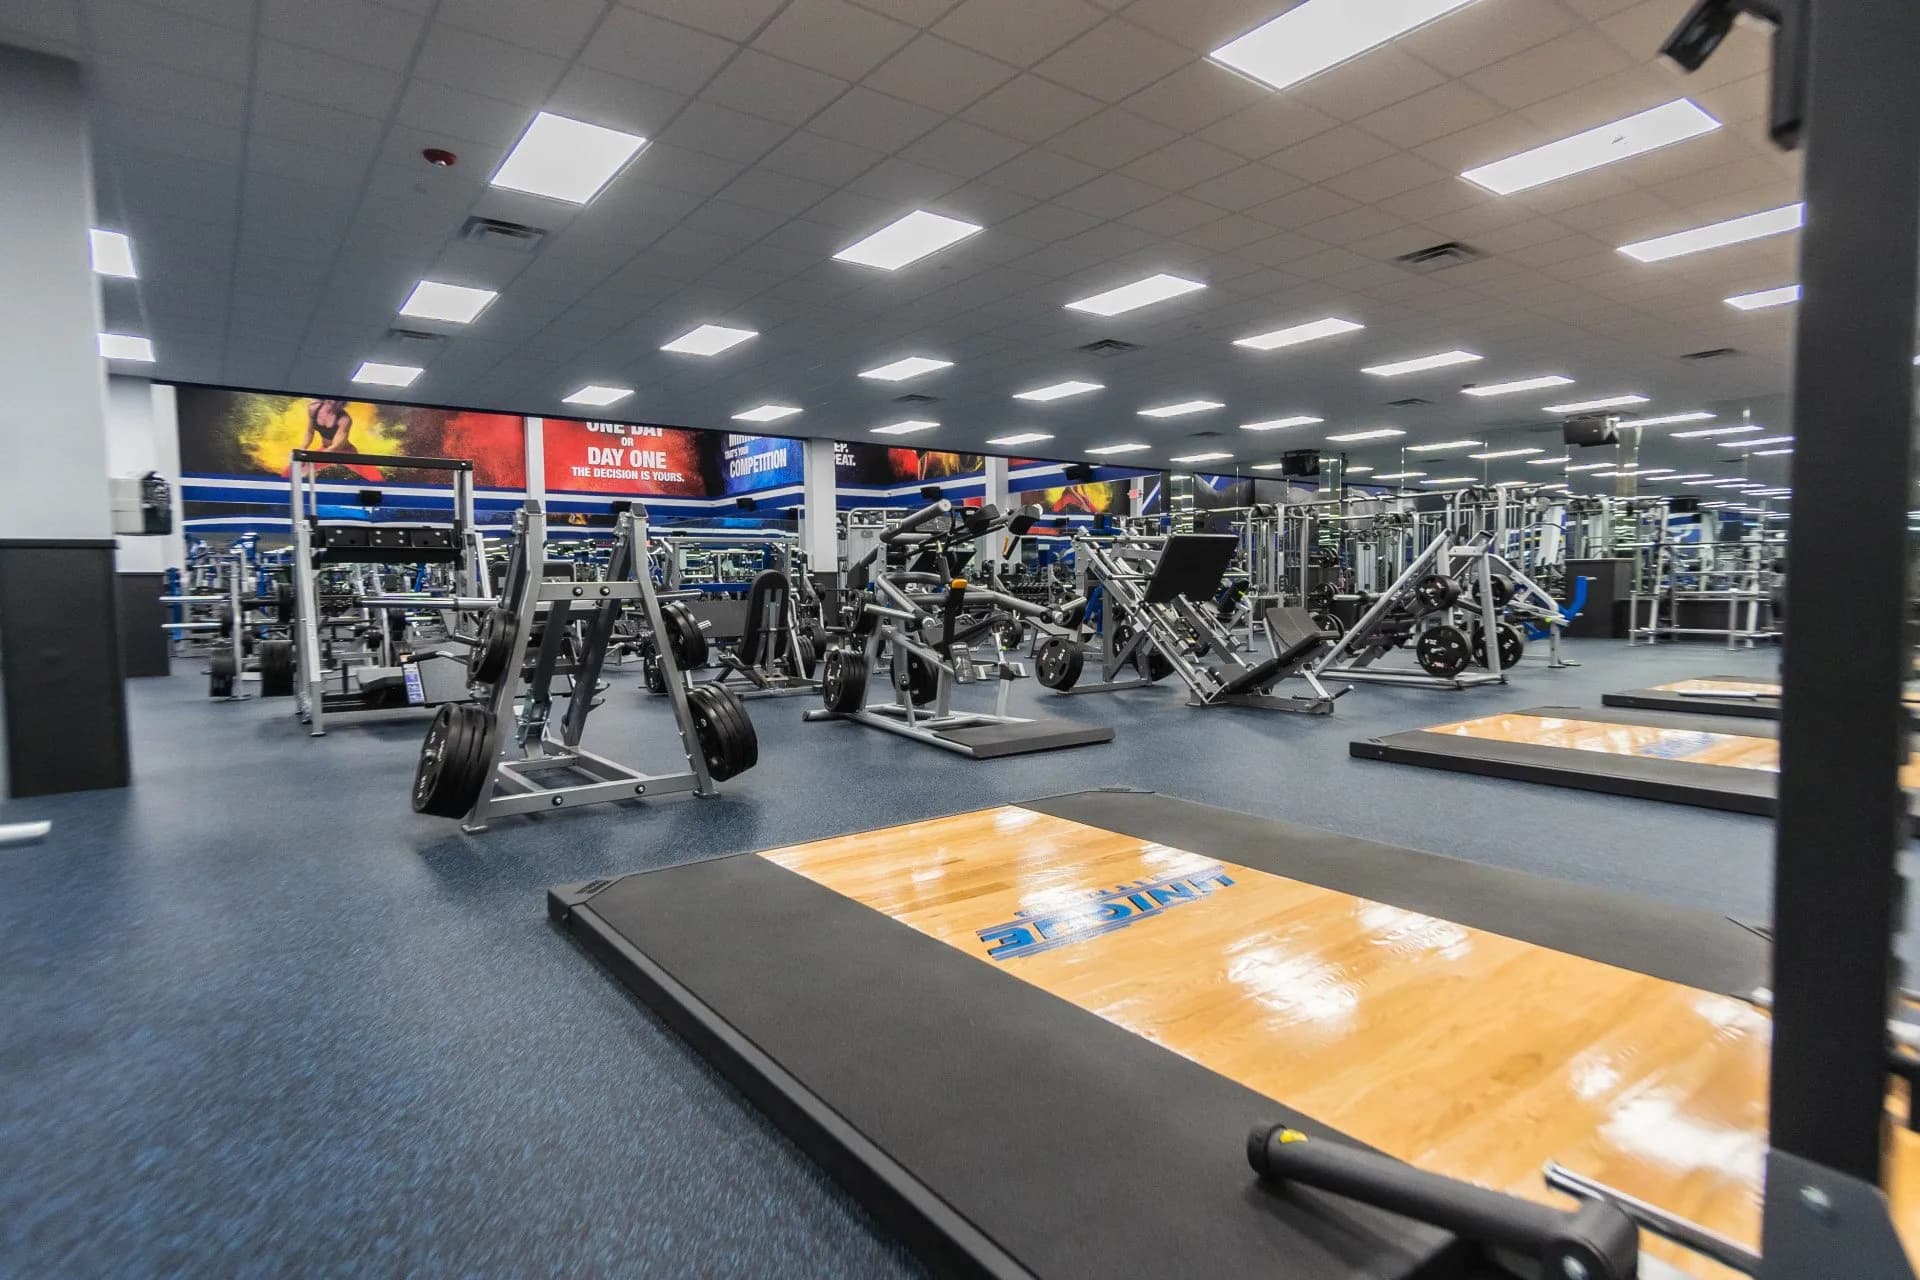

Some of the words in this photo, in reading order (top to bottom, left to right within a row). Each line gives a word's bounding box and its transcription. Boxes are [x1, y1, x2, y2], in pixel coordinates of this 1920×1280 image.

[621, 437, 634, 447] OR
[587, 446, 625, 467] DAY
[629, 450, 667, 469] ONE
[730, 448, 787, 478] COMPETITION
[834, 454, 856, 466] EAT.
[572, 466, 591, 477] THE
[594, 468, 639, 479] DECISION
[641, 471, 651, 480] IS
[652, 471, 685, 482] YOURS.
